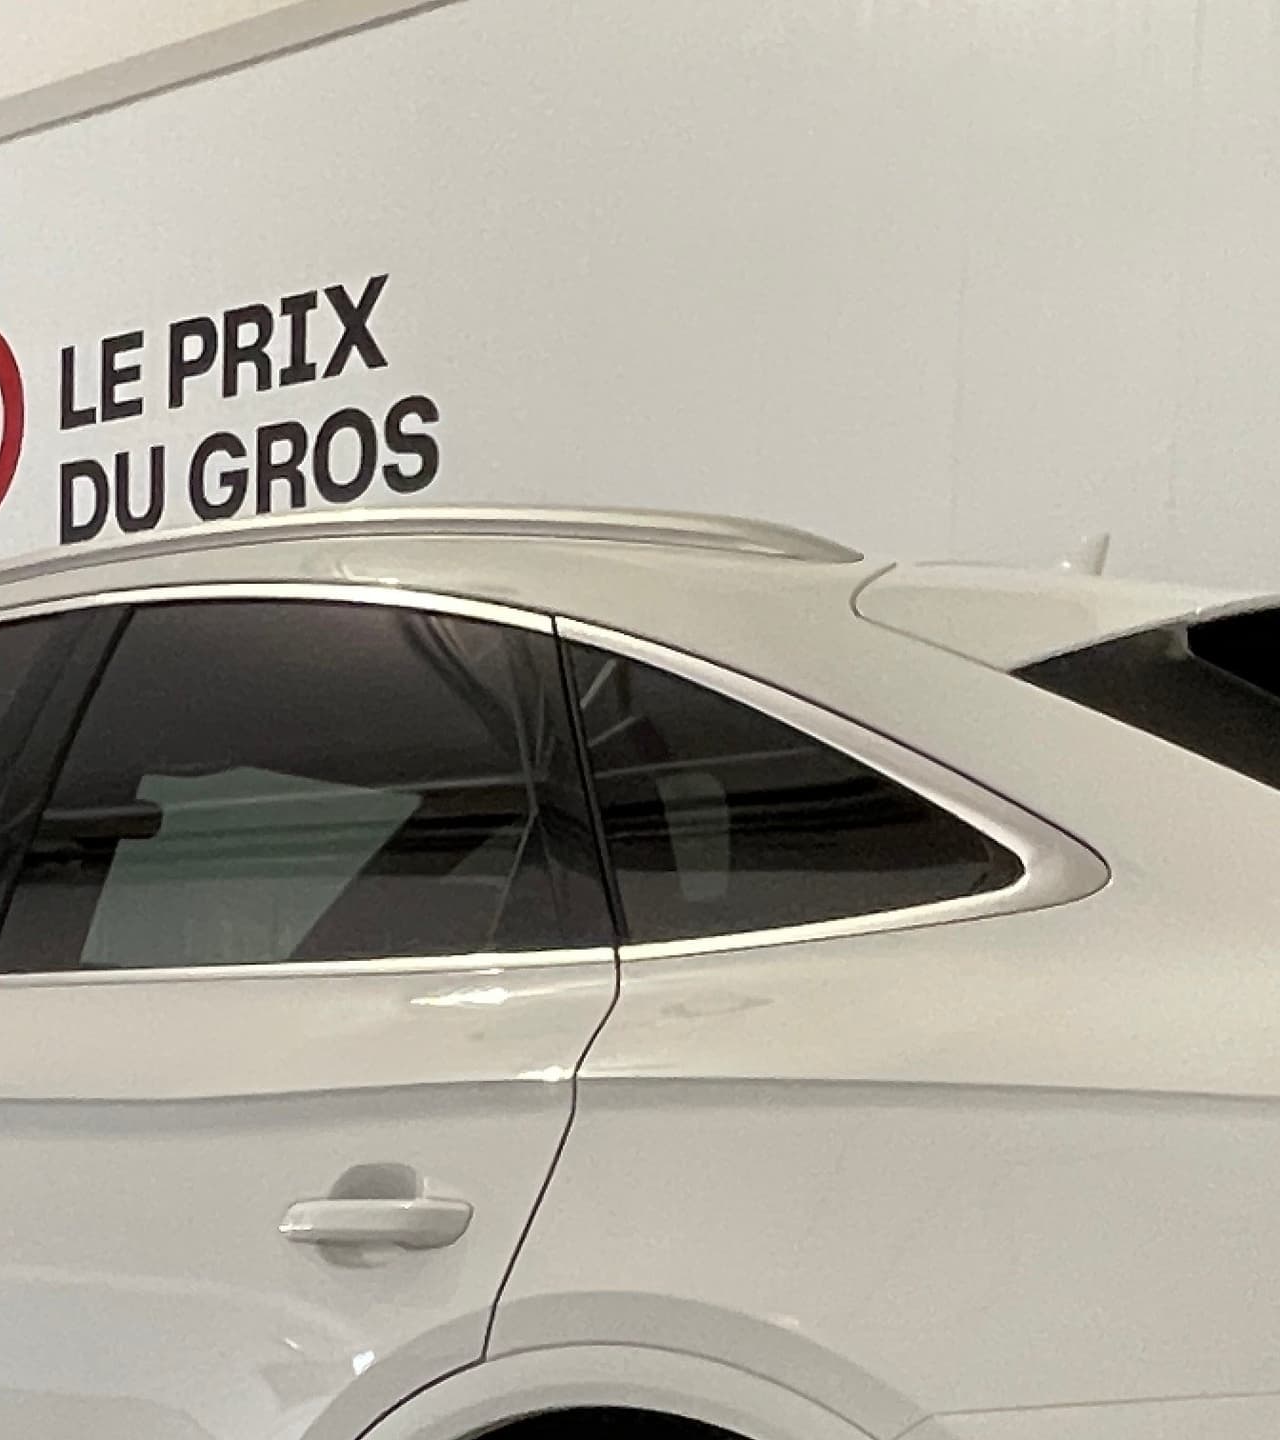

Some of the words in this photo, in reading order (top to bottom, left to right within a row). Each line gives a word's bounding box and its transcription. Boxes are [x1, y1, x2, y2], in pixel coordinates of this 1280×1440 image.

[60, 330, 144, 430] LE
[168, 273, 389, 409] PRIX
[60, 444, 166, 544] DU
[188, 395, 439, 522] GROS
